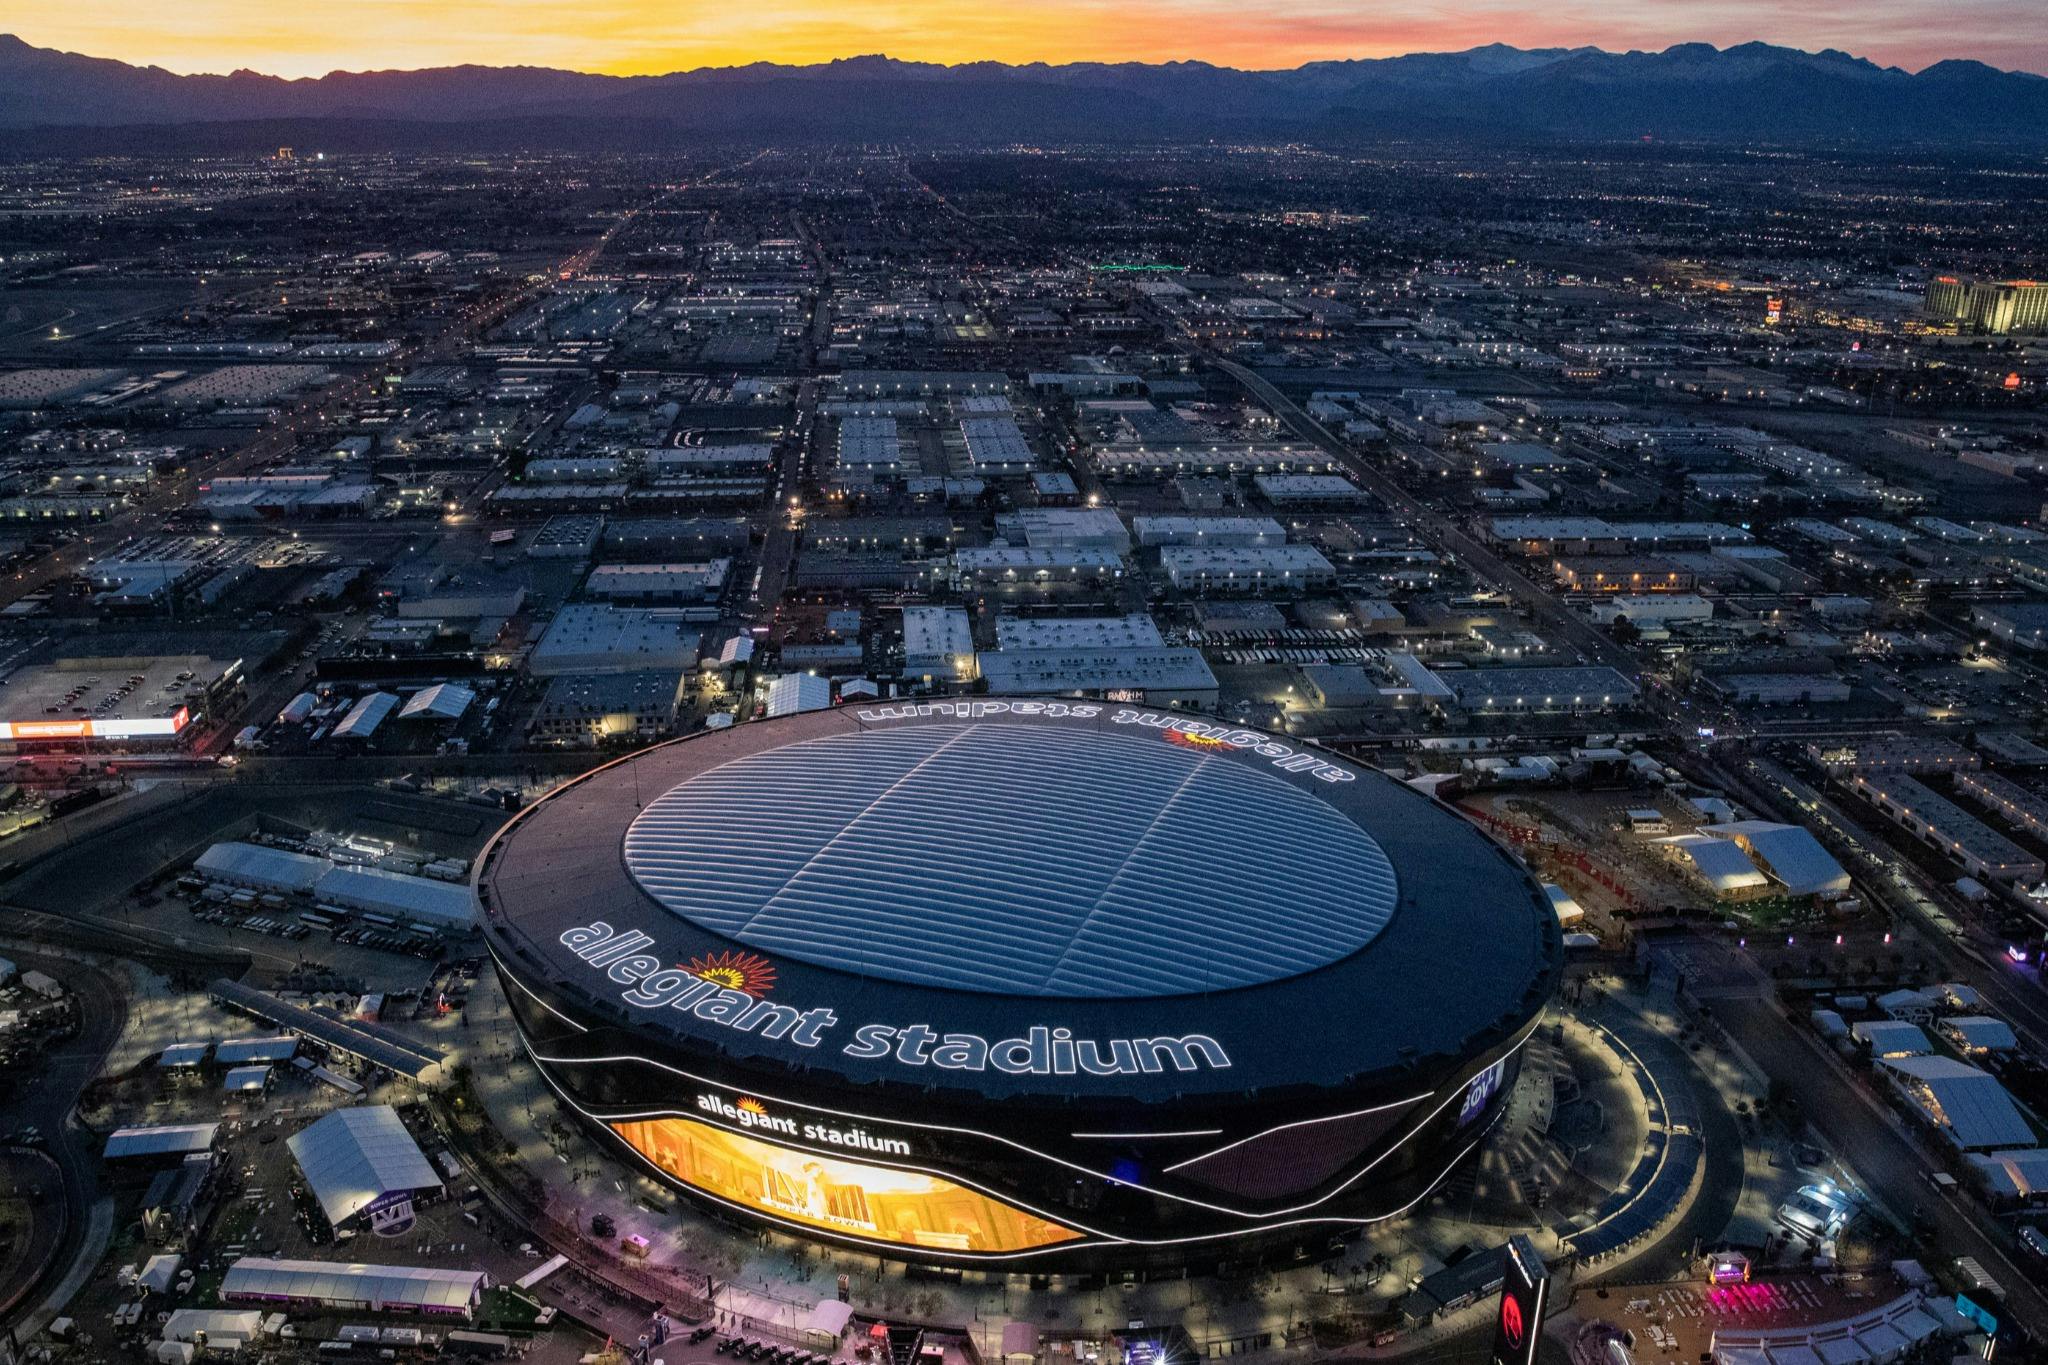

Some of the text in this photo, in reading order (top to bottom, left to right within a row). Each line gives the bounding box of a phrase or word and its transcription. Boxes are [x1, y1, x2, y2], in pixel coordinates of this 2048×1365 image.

[858, 701, 1357, 784] allegiant stadium
[559, 920, 1232, 1075] allegiant stadium
[697, 1093, 911, 1156] allegiant stadium
[823, 1214, 866, 1229] BOWL
